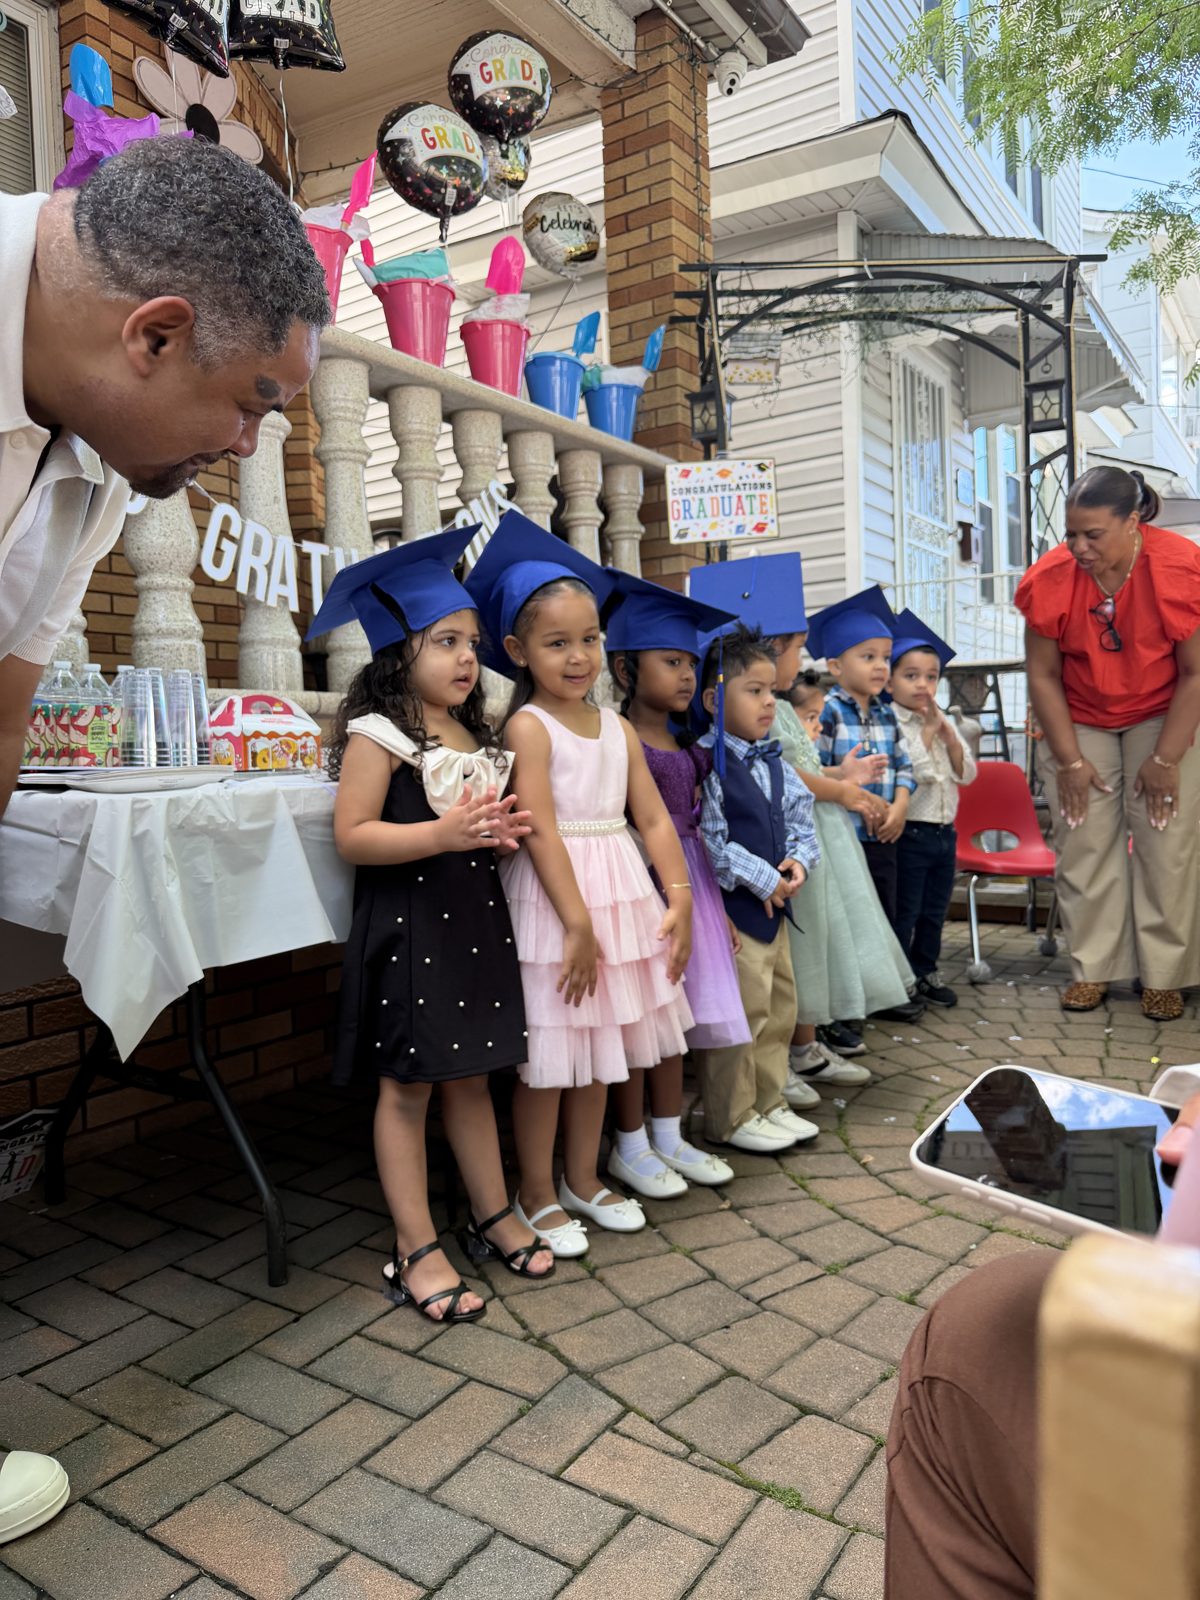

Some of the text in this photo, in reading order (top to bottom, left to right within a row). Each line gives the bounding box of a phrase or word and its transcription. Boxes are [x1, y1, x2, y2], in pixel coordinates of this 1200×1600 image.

[479, 57, 534, 85] GRAD
[420, 125, 477, 155] GRAD
[671, 482, 773, 496] CONGRATULATIONS
[671, 494, 774, 521] GRADUATE!
